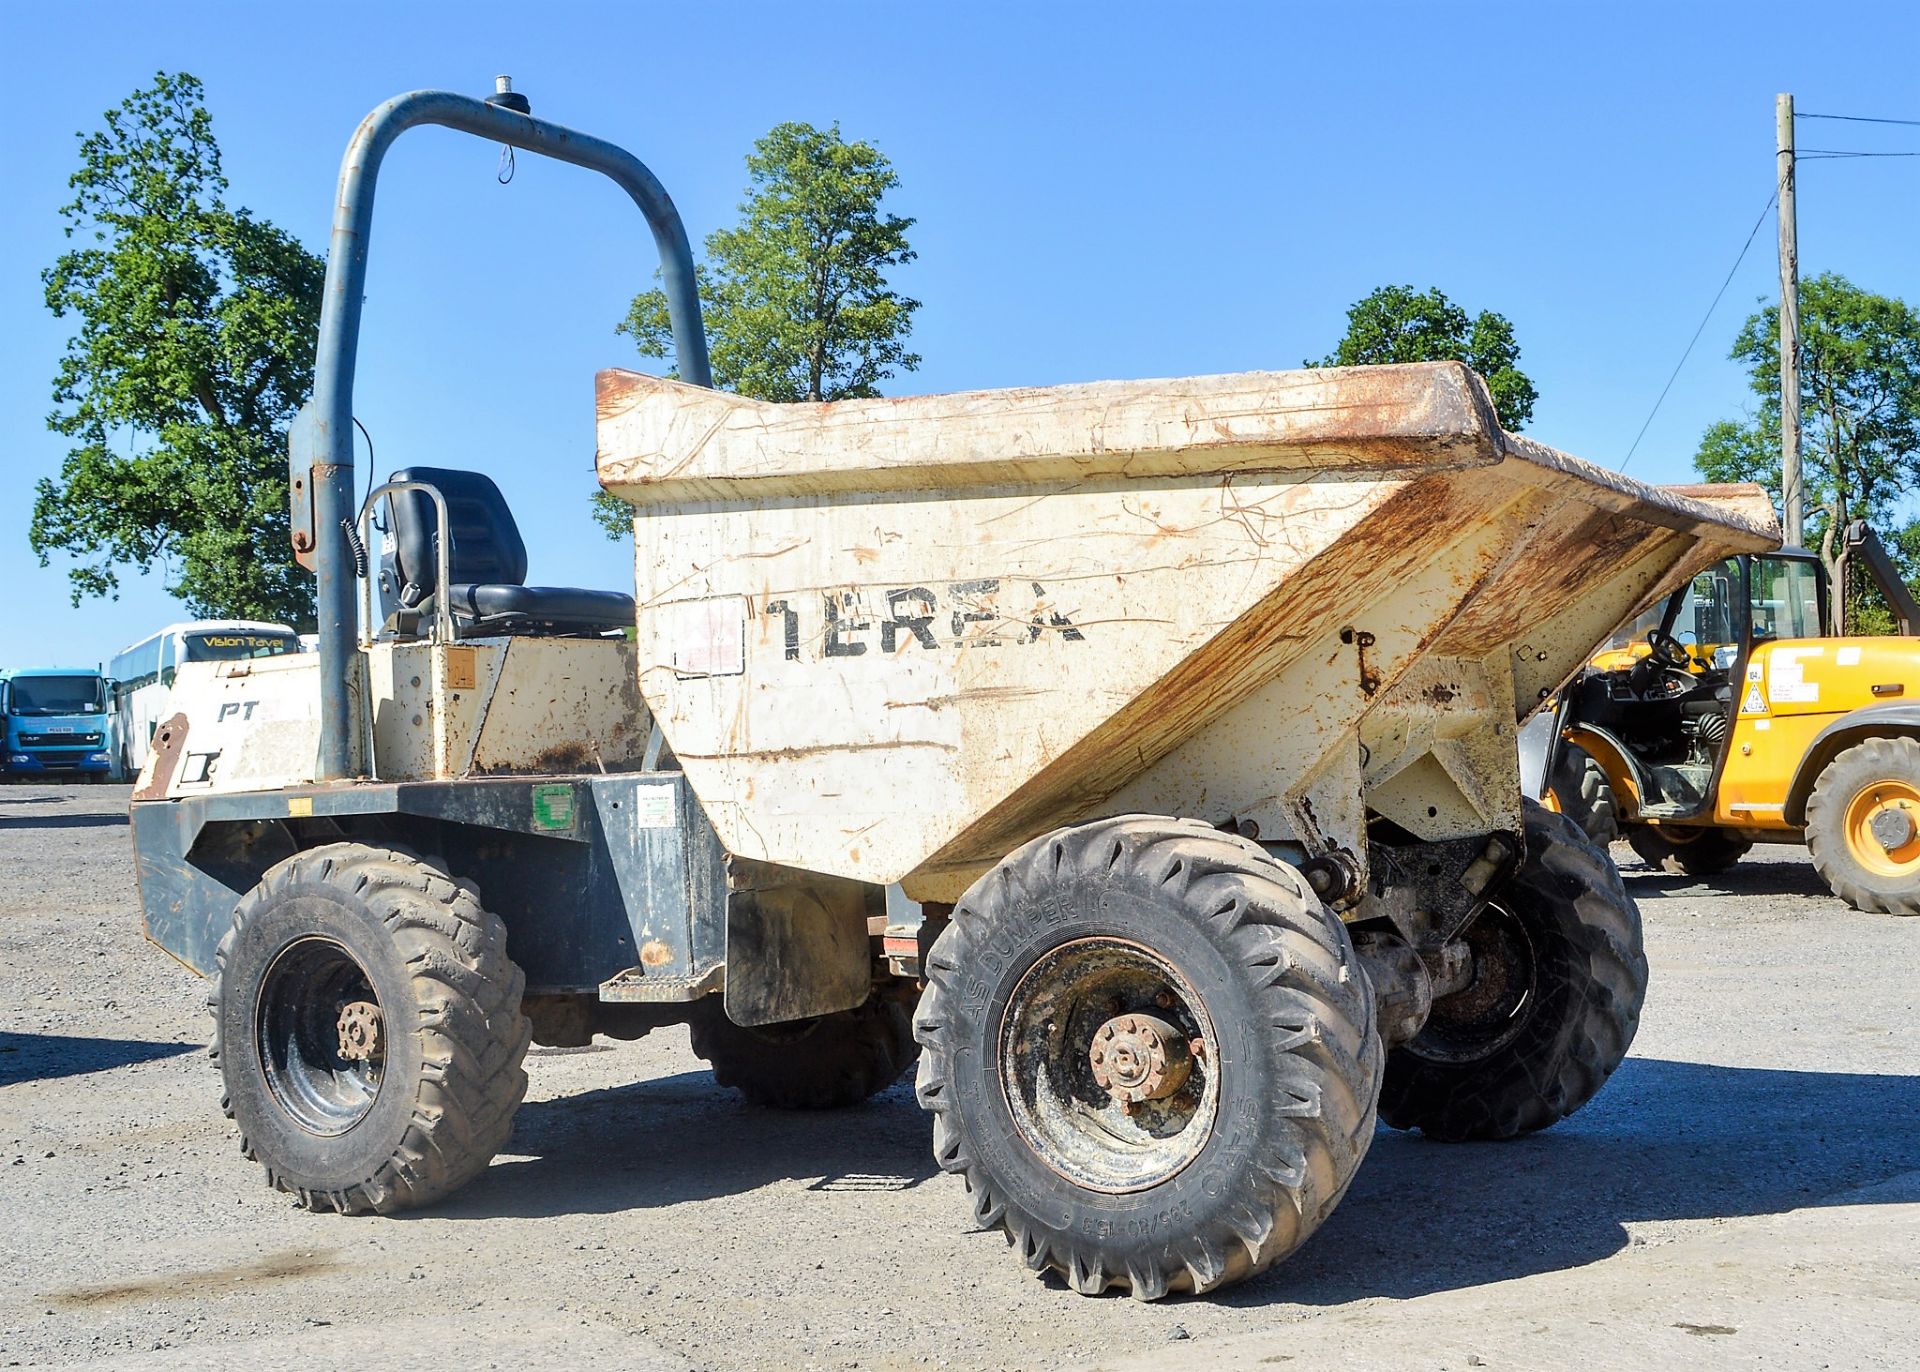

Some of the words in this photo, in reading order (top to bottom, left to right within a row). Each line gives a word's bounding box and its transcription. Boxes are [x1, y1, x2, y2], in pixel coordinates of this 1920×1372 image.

[203, 637, 244, 647] Vision
[246, 637, 284, 647] Travel
[217, 700, 260, 722] PT
[978, 895, 1079, 976] DUMPER
